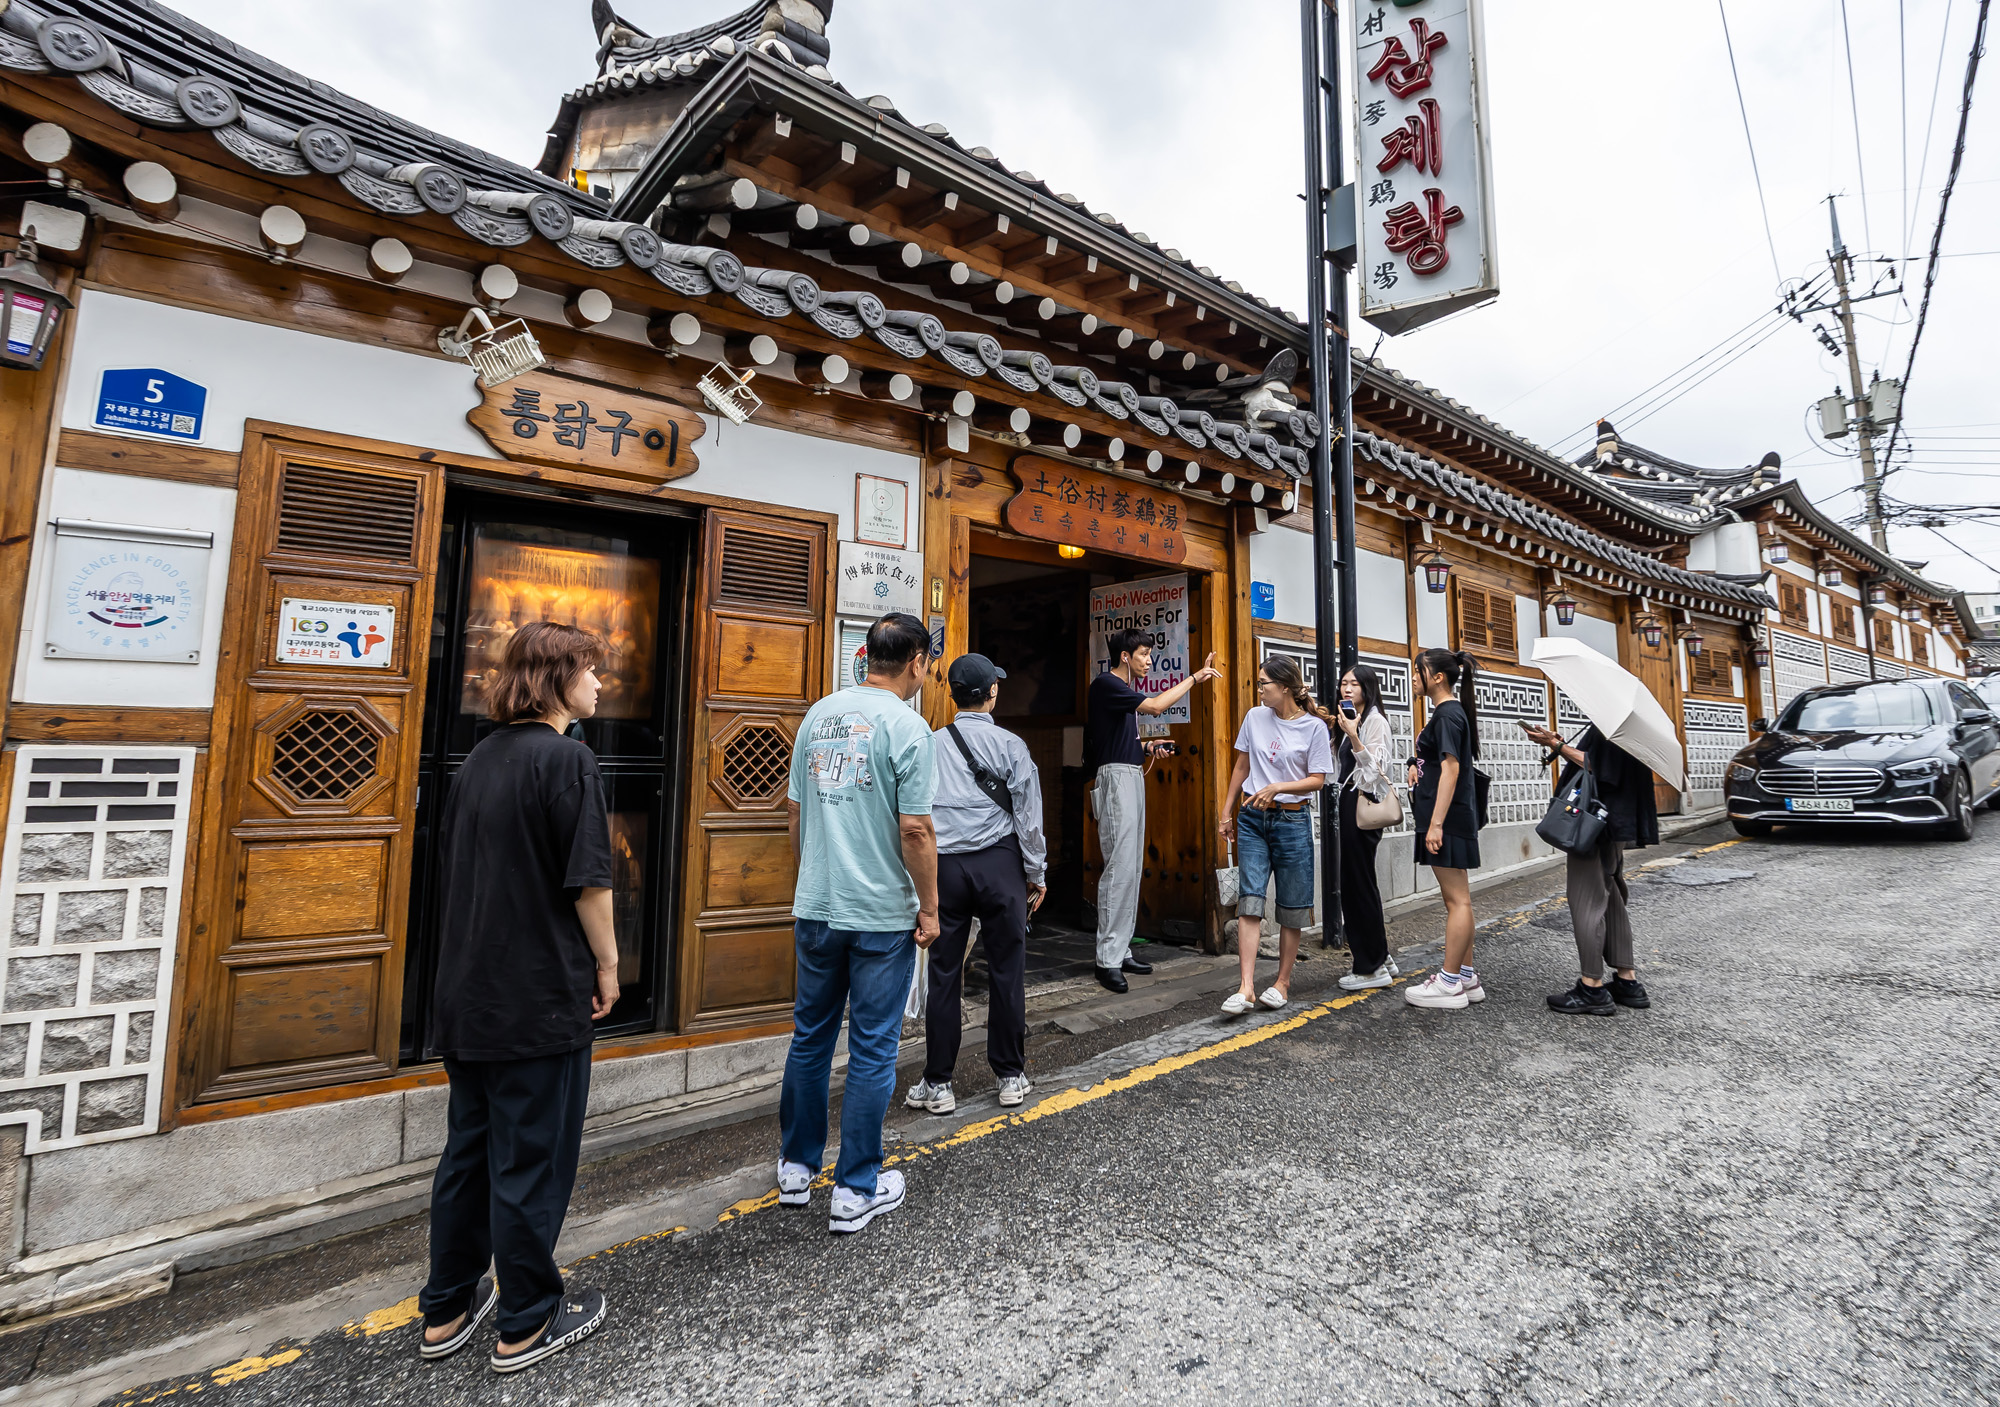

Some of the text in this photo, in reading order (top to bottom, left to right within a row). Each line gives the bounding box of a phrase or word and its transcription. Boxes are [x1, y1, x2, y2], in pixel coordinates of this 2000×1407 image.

[144, 378, 165, 403] 5
[104, 403, 170, 423] 자하문로5길
[500, 388, 679, 467] 통닭구이
[66, 553, 192, 623] EXCELLENCE IN FOOD SAFETY
[1092, 585, 1185, 611] In Hot Weather
[843, 601, 917, 615] TRADITIONAL KOREAN RESTAURANT
[1095, 607, 1183, 632] Thanks For
[286, 648, 340, 659] 후원의 집
[1150, 654, 1182, 672] You
[1823, 800, 1851, 809] 4162
[563, 1312, 603, 1345] crocs
